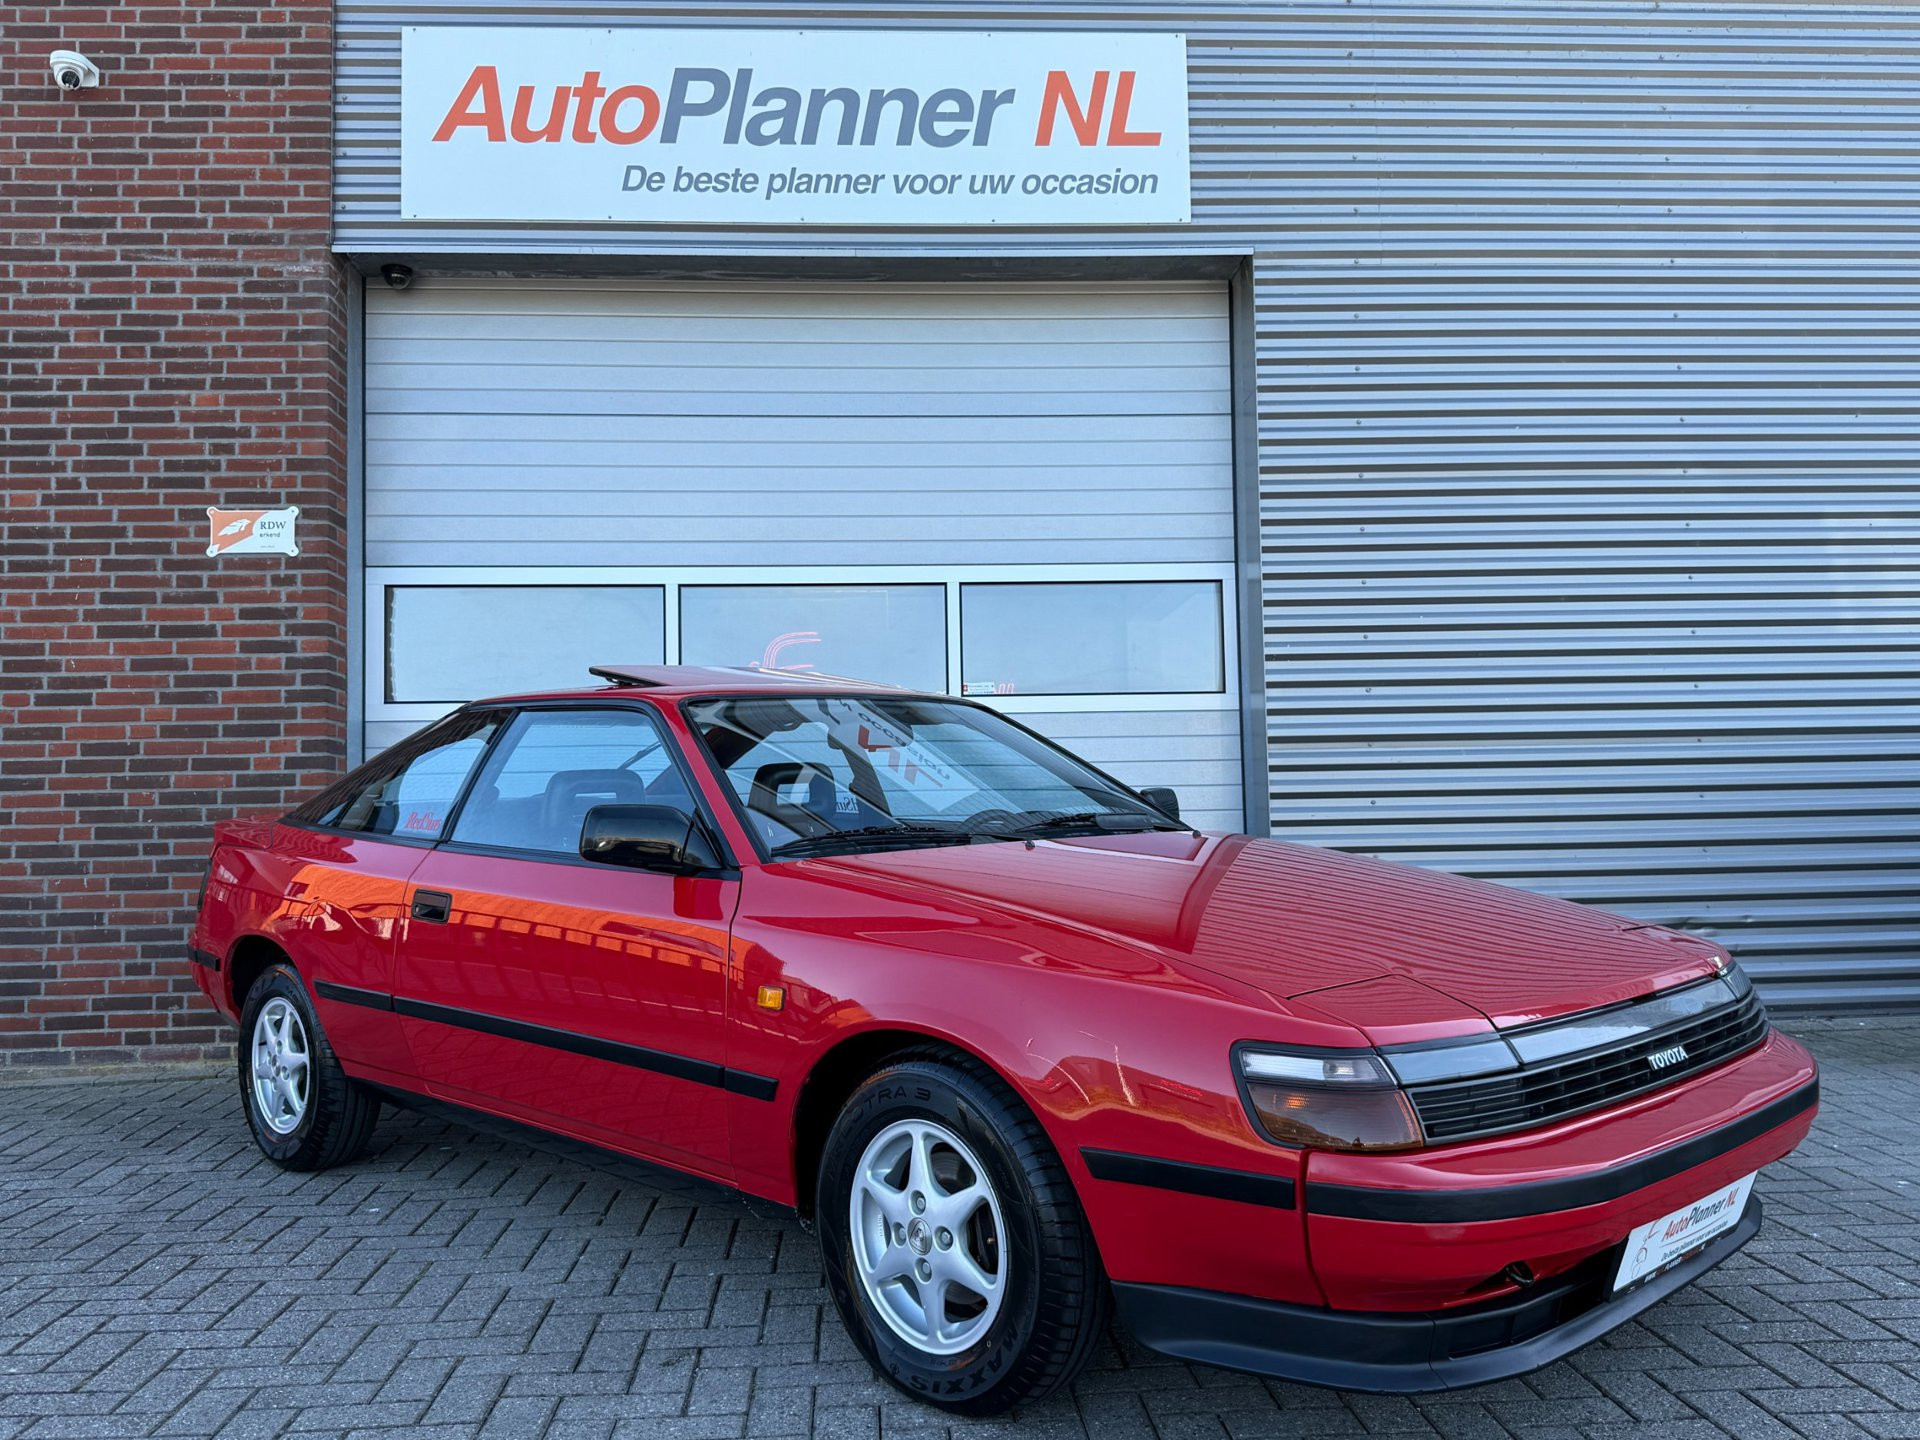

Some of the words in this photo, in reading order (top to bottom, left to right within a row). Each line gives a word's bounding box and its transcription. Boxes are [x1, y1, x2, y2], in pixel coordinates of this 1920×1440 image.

[431, 65, 1014, 147] AutoPlanner
[1034, 70, 1163, 148] NL
[621, 164, 666, 193] De
[673, 165, 760, 194] beste
[765, 167, 886, 201] planner
[892, 173, 963, 195] voor
[968, 174, 1016, 195] uw
[1021, 167, 1160, 195] occasion
[260, 521, 287, 531] RDW
[1648, 1045, 1689, 1070] TOYOTA
[1661, 1197, 1726, 1242] AutoPlanner
[1723, 1187, 1740, 1210] NL
[909, 1328, 1018, 1395] MAXXIS
